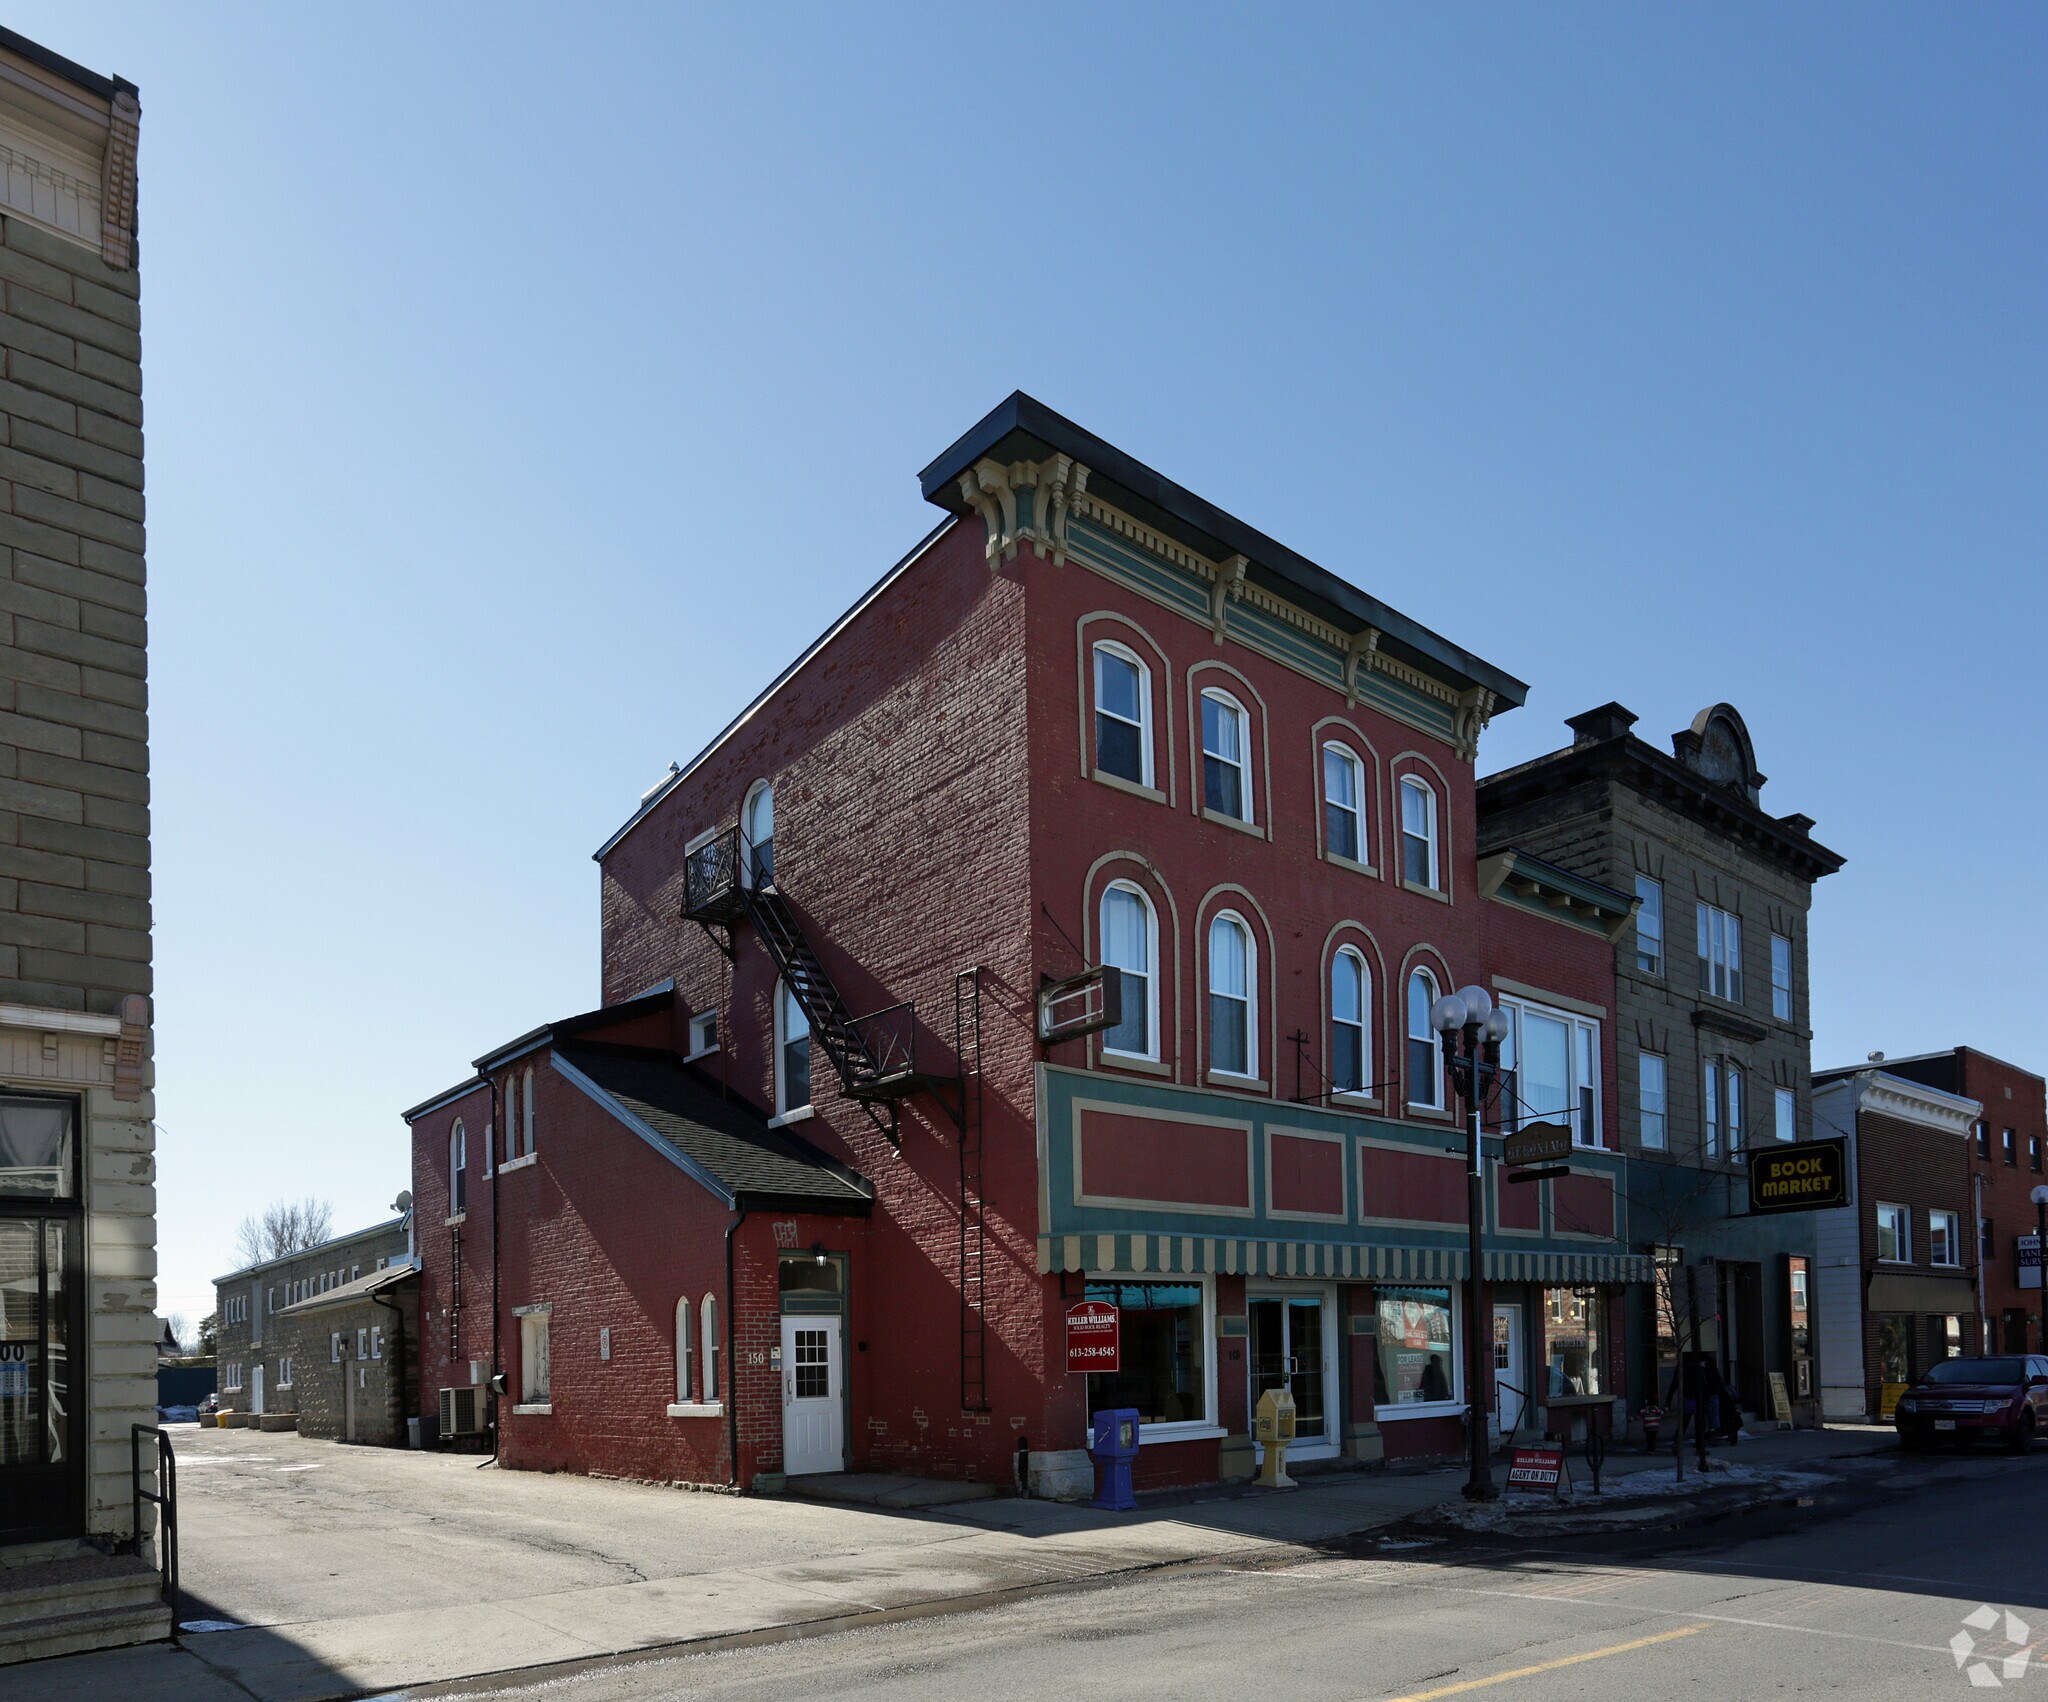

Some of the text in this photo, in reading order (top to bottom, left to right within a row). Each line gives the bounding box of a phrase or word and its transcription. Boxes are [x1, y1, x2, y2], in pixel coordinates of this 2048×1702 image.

[1771, 1158, 1822, 1178] BOOK
[1763, 1176, 1832, 1197] MARKET
[1068, 1316, 1088, 1325] KELLER
[748, 1352, 764, 1364] 150
[1070, 1347, 1115, 1358] 613-258-4545
[1408, 1355, 1423, 1363] LEASE
[1511, 1470, 1557, 1481] AGENT ON DUTY
